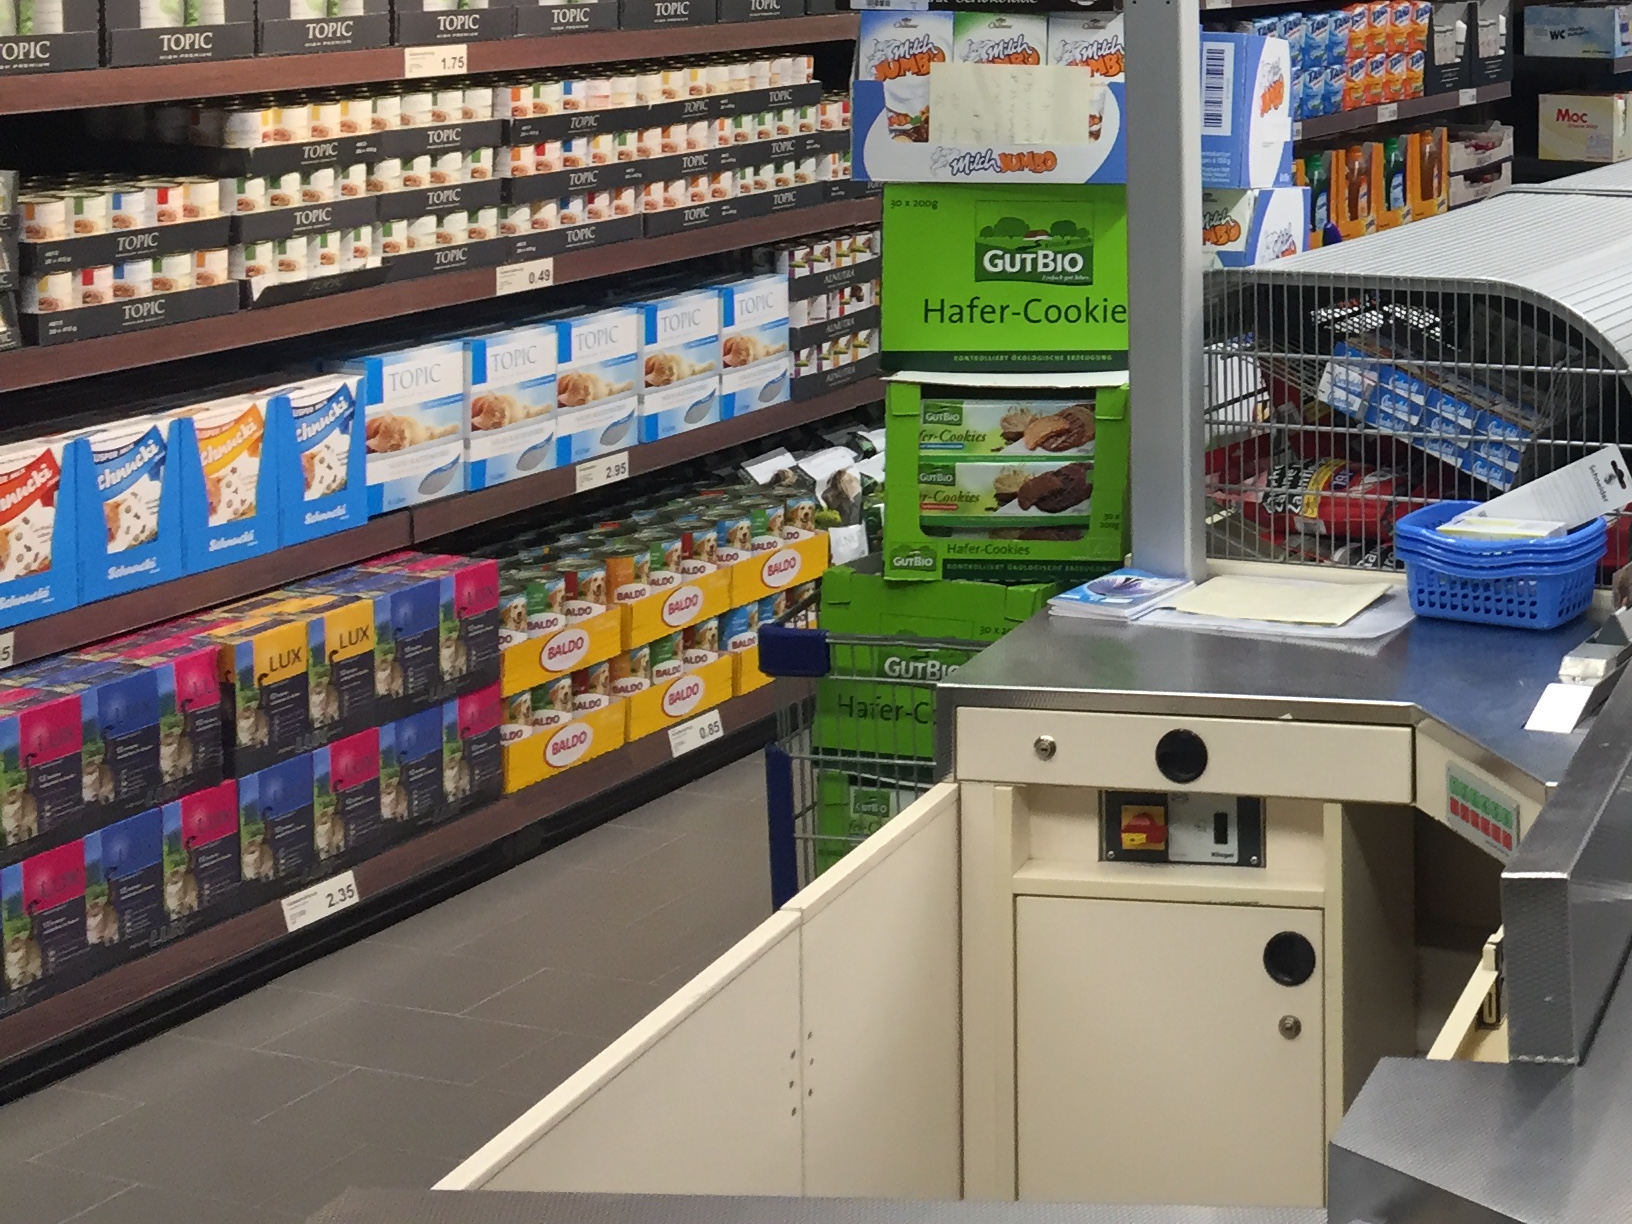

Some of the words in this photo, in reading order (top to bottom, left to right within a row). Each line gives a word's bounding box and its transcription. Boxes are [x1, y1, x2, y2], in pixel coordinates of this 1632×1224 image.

[551, 8, 590, 24] TOPIC
[654, 1, 691, 16] TOPIC
[305, 21, 354, 40] TOPIC
[437, 14, 480, 31] TOPIC
[159, 32, 213, 52] TOPIC
[1549, 29, 1566, 41] WC
[0, 41, 50, 61] OPIC
[441, 56, 465, 71] 1.75
[1556, 108, 1588, 123] Moc
[427, 128, 461, 144] TOPIC
[302, 142, 338, 159] TOPIC
[682, 154, 709, 169] TOPIC
[950, 148, 1001, 175] Milch
[999, 150, 1057, 174] JUMBO
[569, 171, 599, 186] TOPIC
[427, 188, 462, 205] TOPIC
[913, 198, 938, 210] 200g
[293, 208, 333, 226] TOPIC
[684, 206, 710, 222] TOPIC
[117, 232, 159, 252] TOPIC
[566, 227, 596, 244] TOPIC
[434, 248, 468, 265] TOPIC
[983, 249, 1085, 274] GUTBIO
[528, 269, 551, 285] 0.49
[122, 299, 166, 320] TOPIC
[737, 292, 775, 317] TOPIC
[923, 296, 1127, 324] Hafer-Cookie
[661, 309, 702, 333] TOPIC
[575, 325, 619, 351] TOPIC
[490, 345, 538, 373] TOPIC
[388, 363, 442, 392] TOPIC
[919, 429, 987, 443] fer-Cookies
[605, 463, 627, 479] 2.95
[920, 490, 980, 504] r-Cookies
[947, 543, 1031, 556] Hafer-Cookies
[767, 556, 797, 576] BALDO
[617, 588, 647, 601] BALDO
[565, 605, 592, 617] ALDO
[668, 594, 699, 616] BALDO
[339, 624, 370, 650] LUX
[547, 637, 584, 660] BALDO
[269, 647, 302, 673] LUX
[668, 683, 699, 706] BALDO
[699, 721, 720, 739] 0.85
[552, 733, 588, 755] BALDO
[325, 883, 355, 909] 2.35
